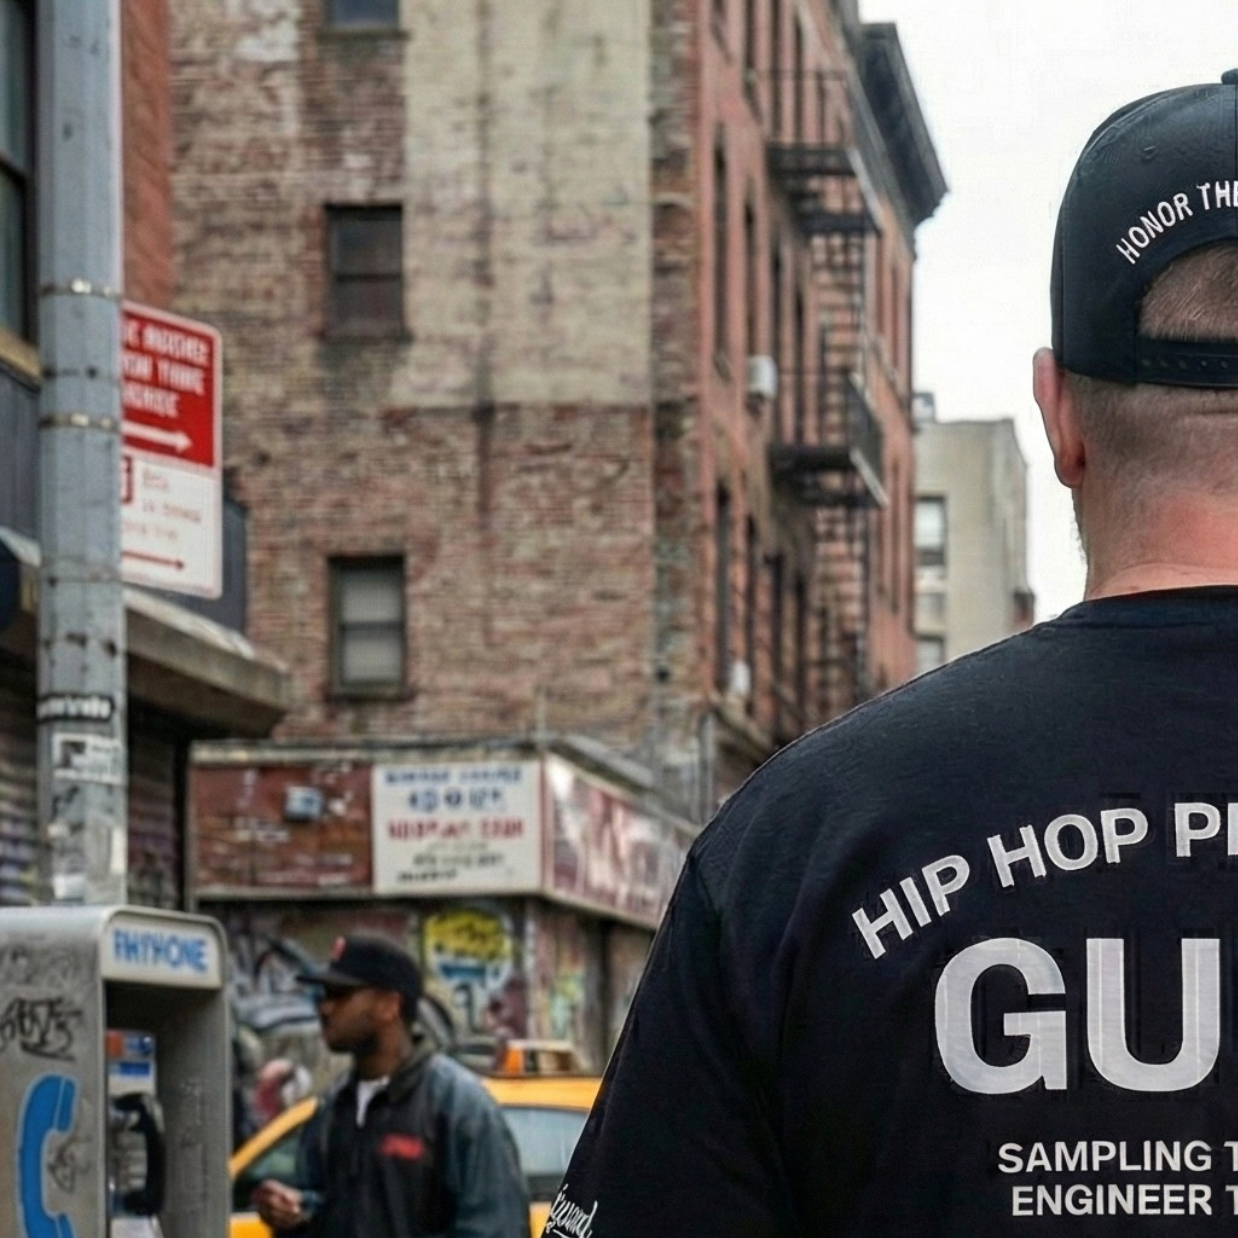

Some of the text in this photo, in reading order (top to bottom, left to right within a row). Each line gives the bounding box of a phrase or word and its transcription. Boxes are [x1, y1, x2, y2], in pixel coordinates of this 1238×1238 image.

[1115, 192, 1194, 265] HONOR
[851, 854, 970, 960] HIP
[986, 807, 1149, 888] HOP
[998, 1140, 1212, 1173] SAMPLING
[1012, 1184, 1212, 1216] ENGINEER
